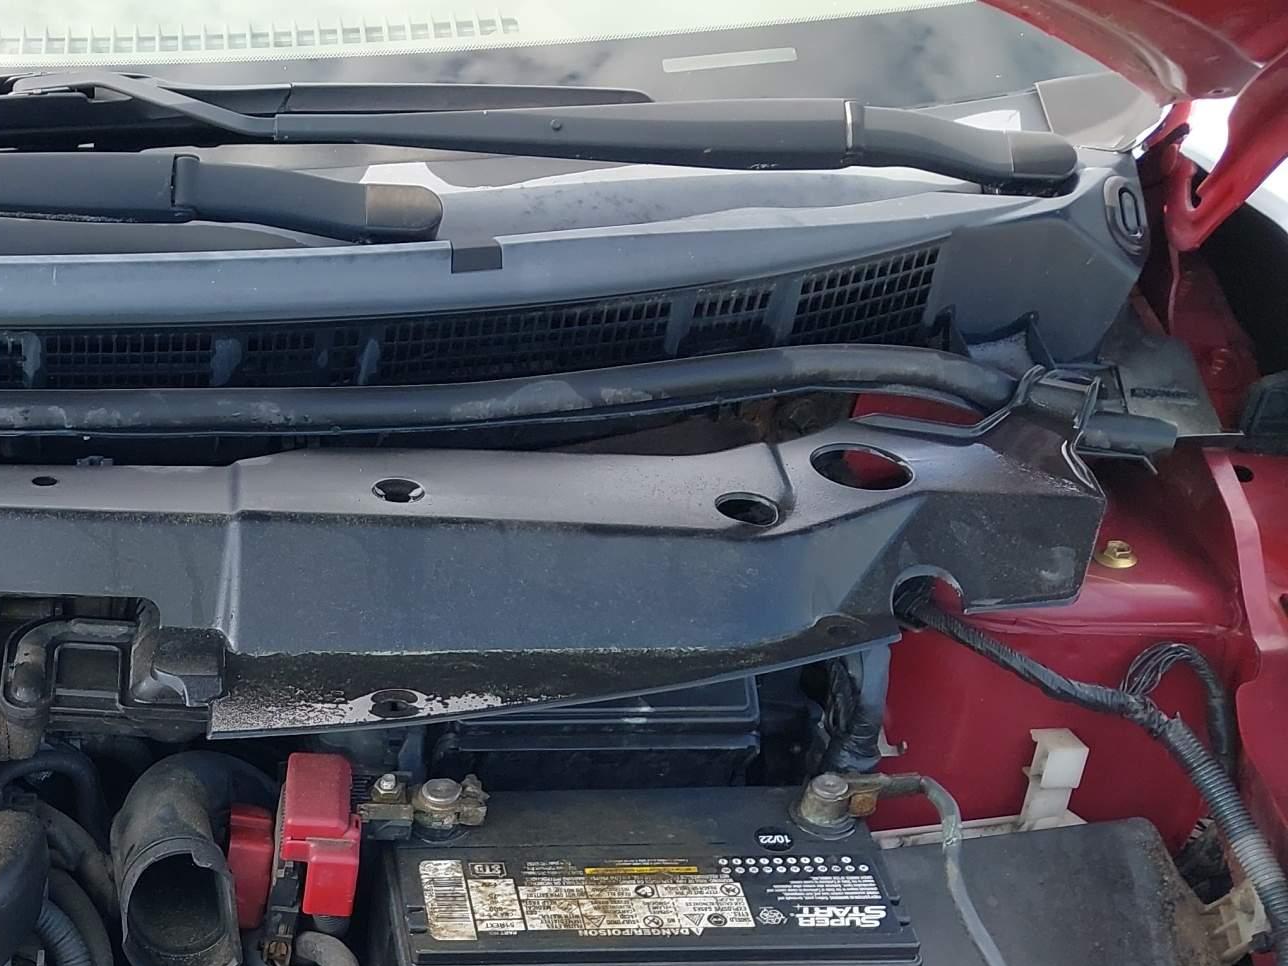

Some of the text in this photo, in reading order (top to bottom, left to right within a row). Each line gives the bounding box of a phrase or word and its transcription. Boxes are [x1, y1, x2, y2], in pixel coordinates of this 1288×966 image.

[758, 835, 791, 844] 10/22
[795, 905, 886, 919] START
[798, 917, 880, 927] SUPER
[578, 928, 690, 937] DANGER/POISON
